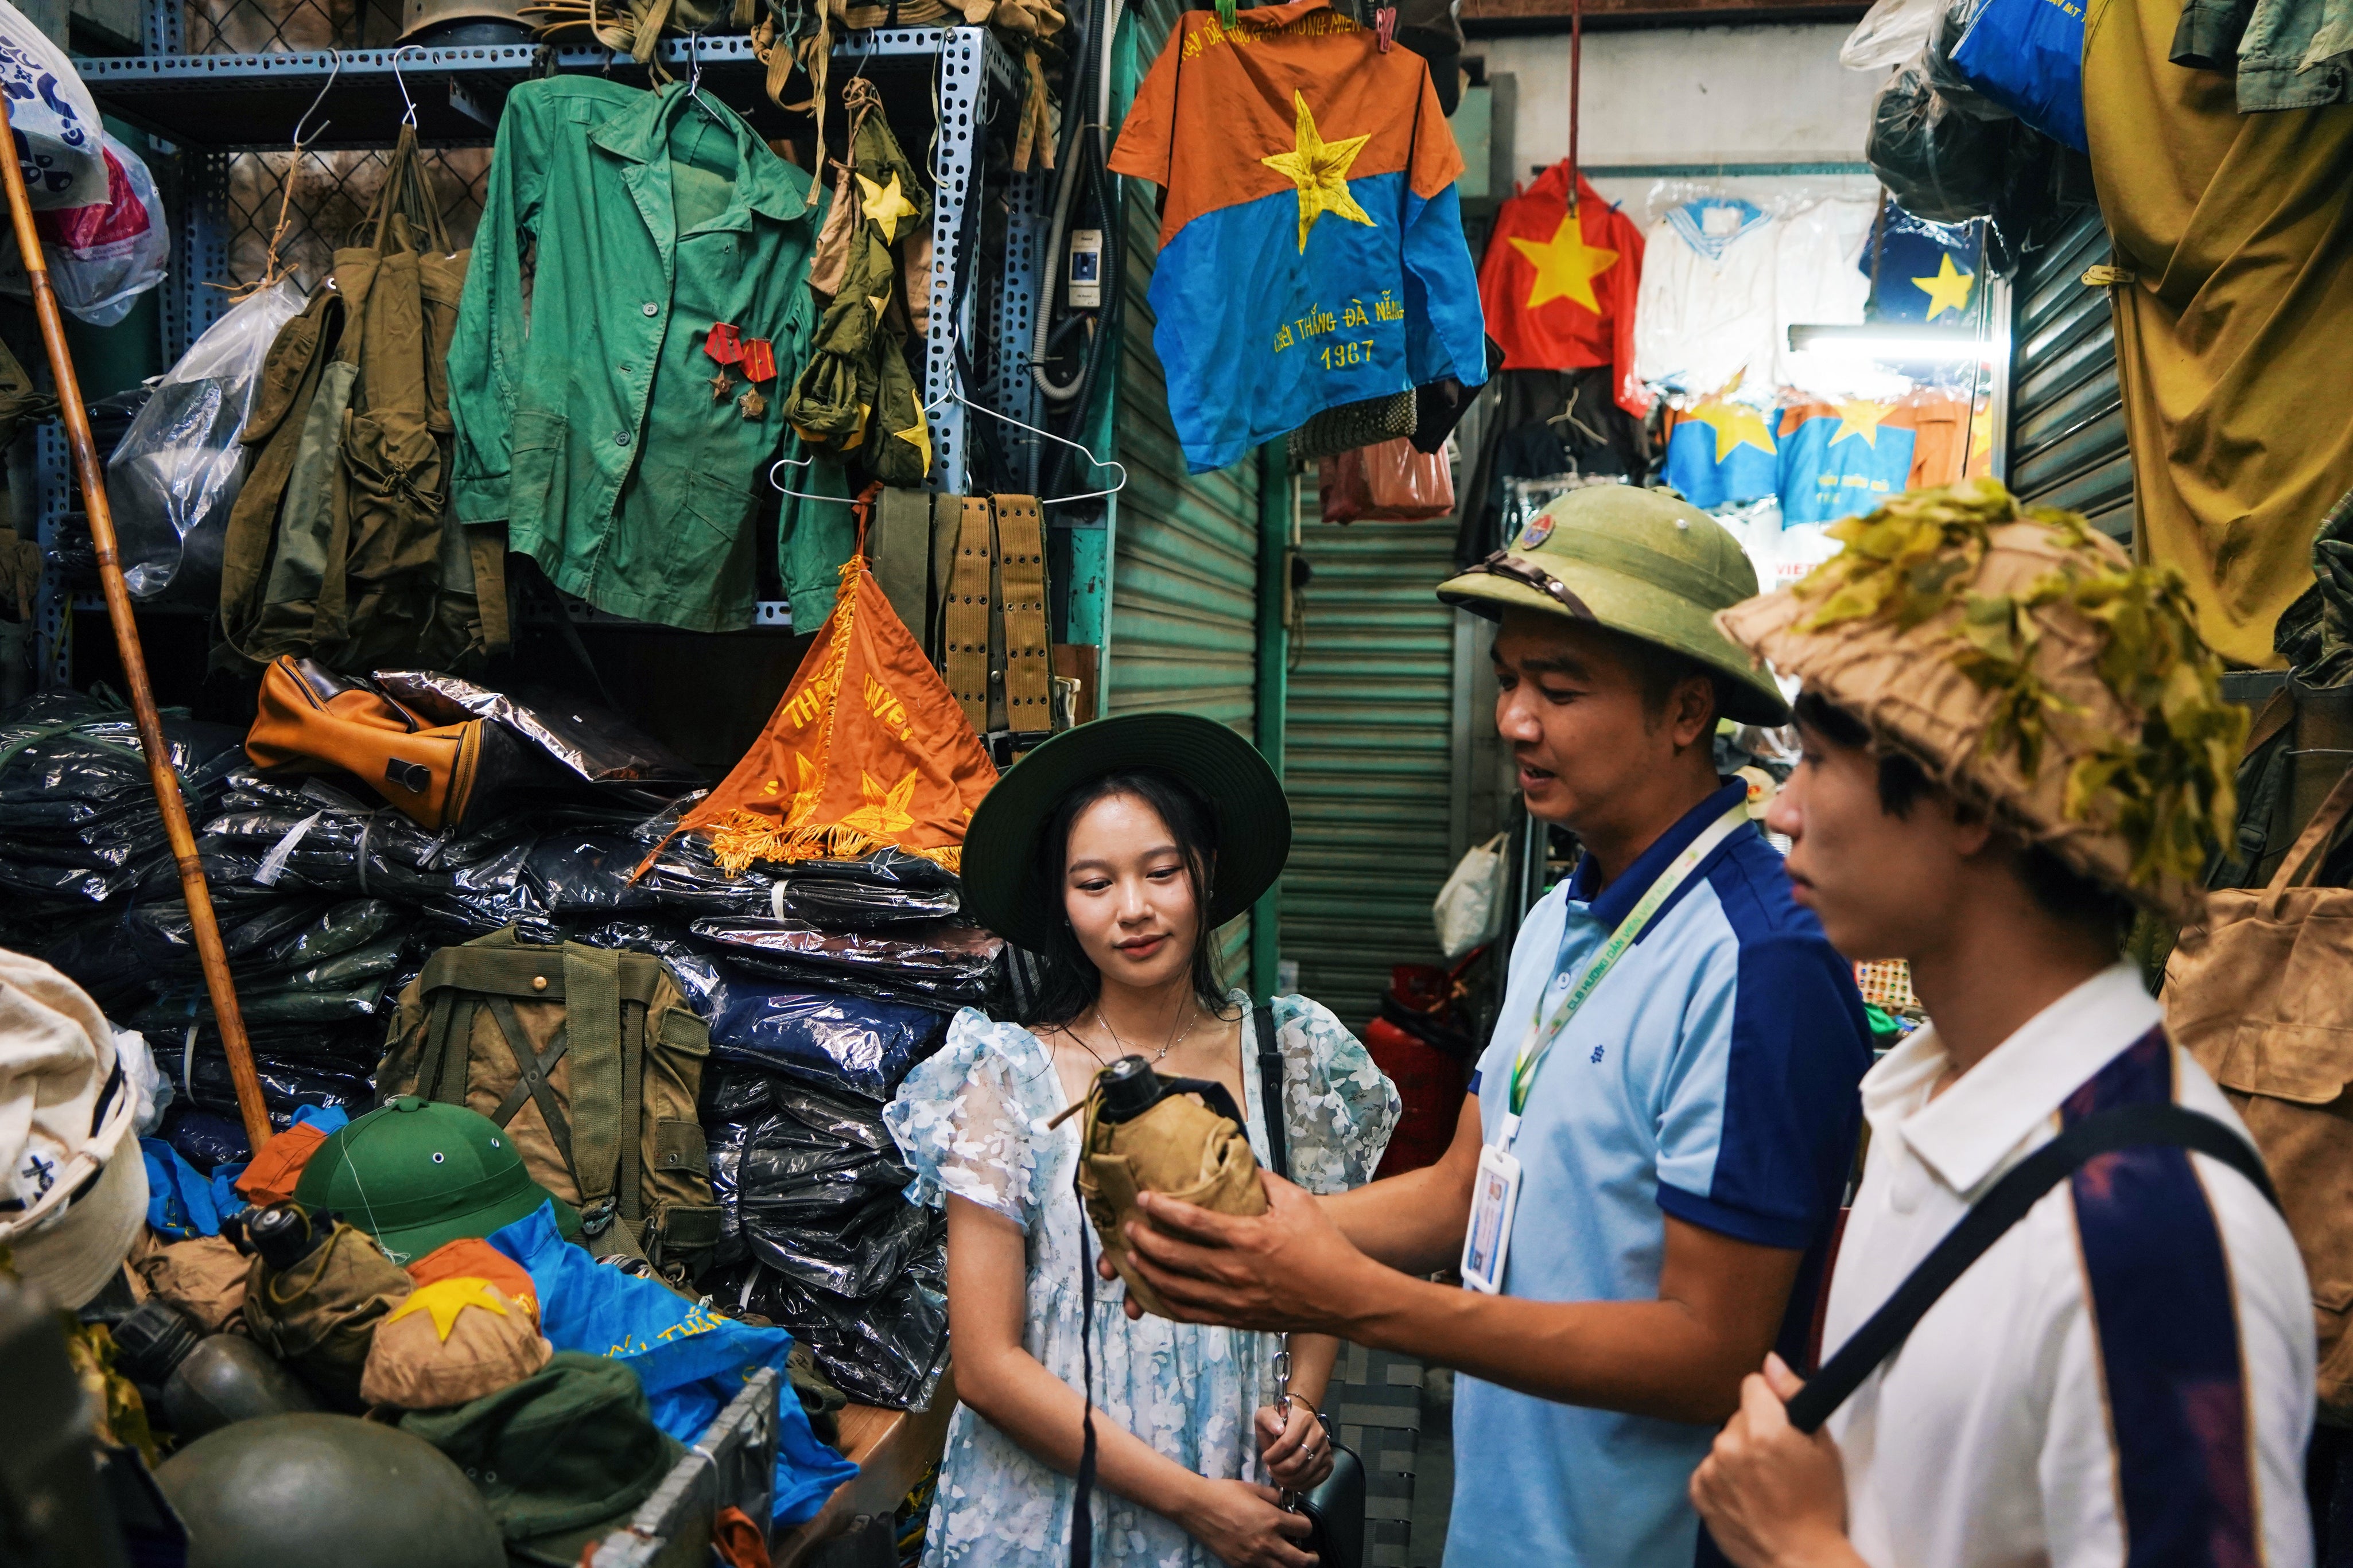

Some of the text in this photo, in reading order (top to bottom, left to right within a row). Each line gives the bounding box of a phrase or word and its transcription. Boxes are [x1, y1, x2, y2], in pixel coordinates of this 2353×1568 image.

[1294, 302, 1337, 340] THẮNG
[1342, 298, 1369, 328] ĐÀ
[1321, 340, 1374, 370] 1967
[1567, 989, 1585, 1010] CLB
[1657, 874, 1677, 896] NAM
